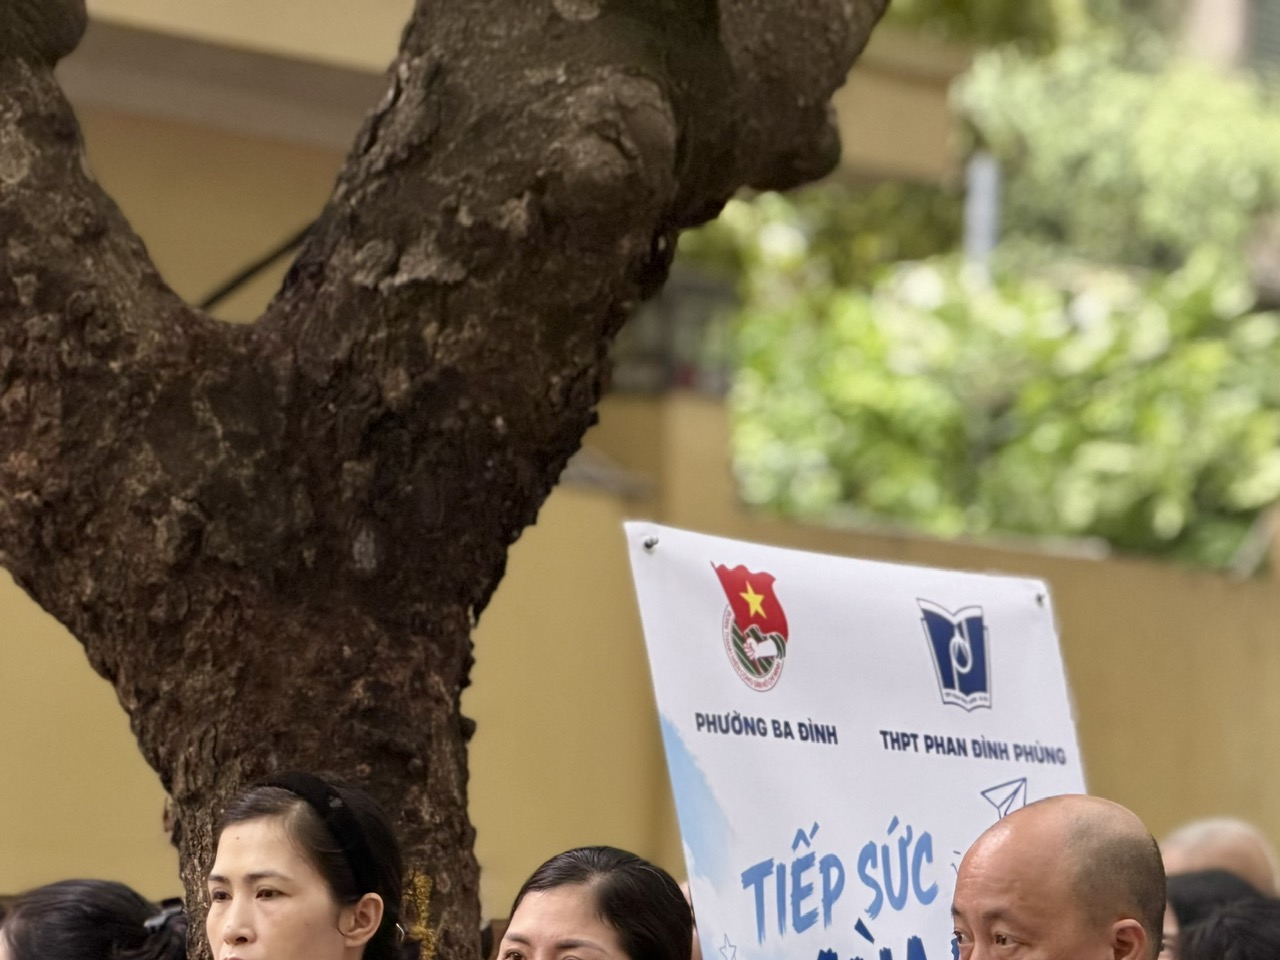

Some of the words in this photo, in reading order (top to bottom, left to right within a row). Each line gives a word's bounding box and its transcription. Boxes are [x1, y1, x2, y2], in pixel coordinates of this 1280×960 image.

[695, 710, 768, 737] PHƯỜNG
[771, 719, 795, 740] BA
[797, 717, 839, 745] ĐÌNH
[879, 730, 919, 752] THPT
[923, 734, 968, 757] PHAN
[971, 735, 1010, 761] ĐÌNH
[1012, 740, 1067, 765] PHÙNG
[741, 821, 845, 945] TIẾP
[857, 815, 939, 920] SỨC
